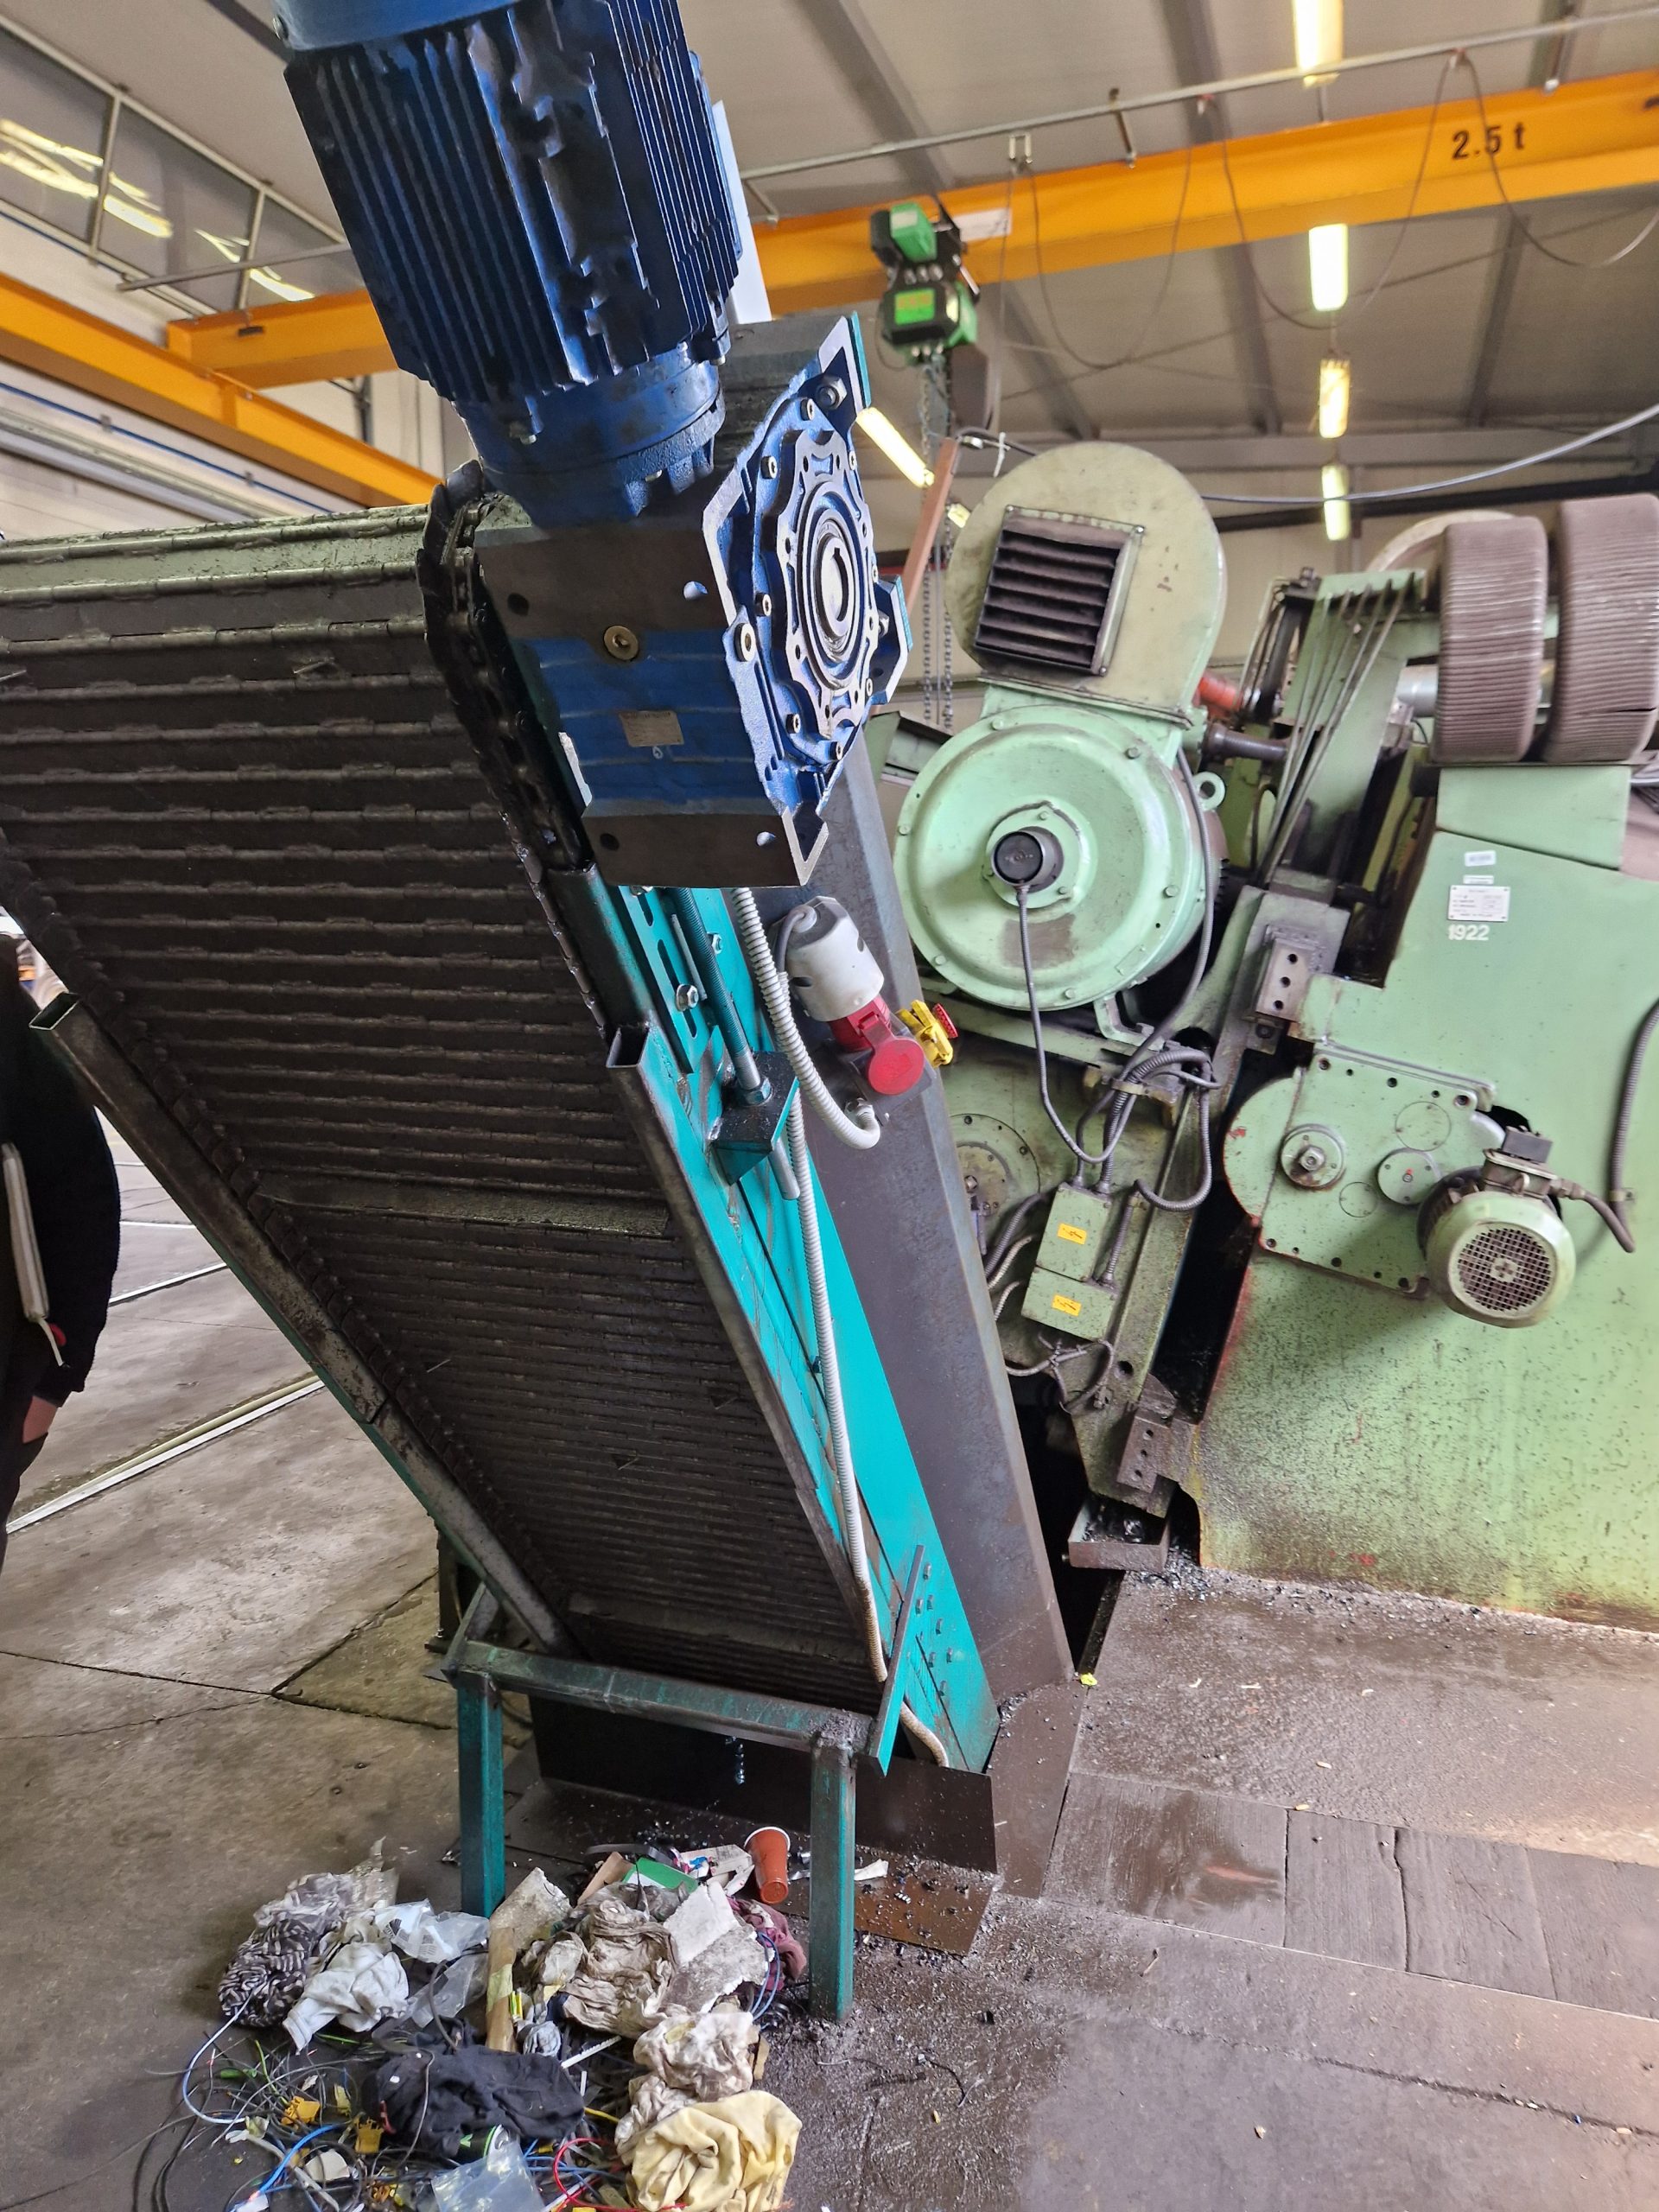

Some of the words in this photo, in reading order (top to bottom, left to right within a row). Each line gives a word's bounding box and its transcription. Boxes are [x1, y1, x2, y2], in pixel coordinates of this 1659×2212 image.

[1452, 125, 1502, 161] 2.5
[1513, 122, 1526, 150] t
[1447, 924, 1491, 941] 1922
